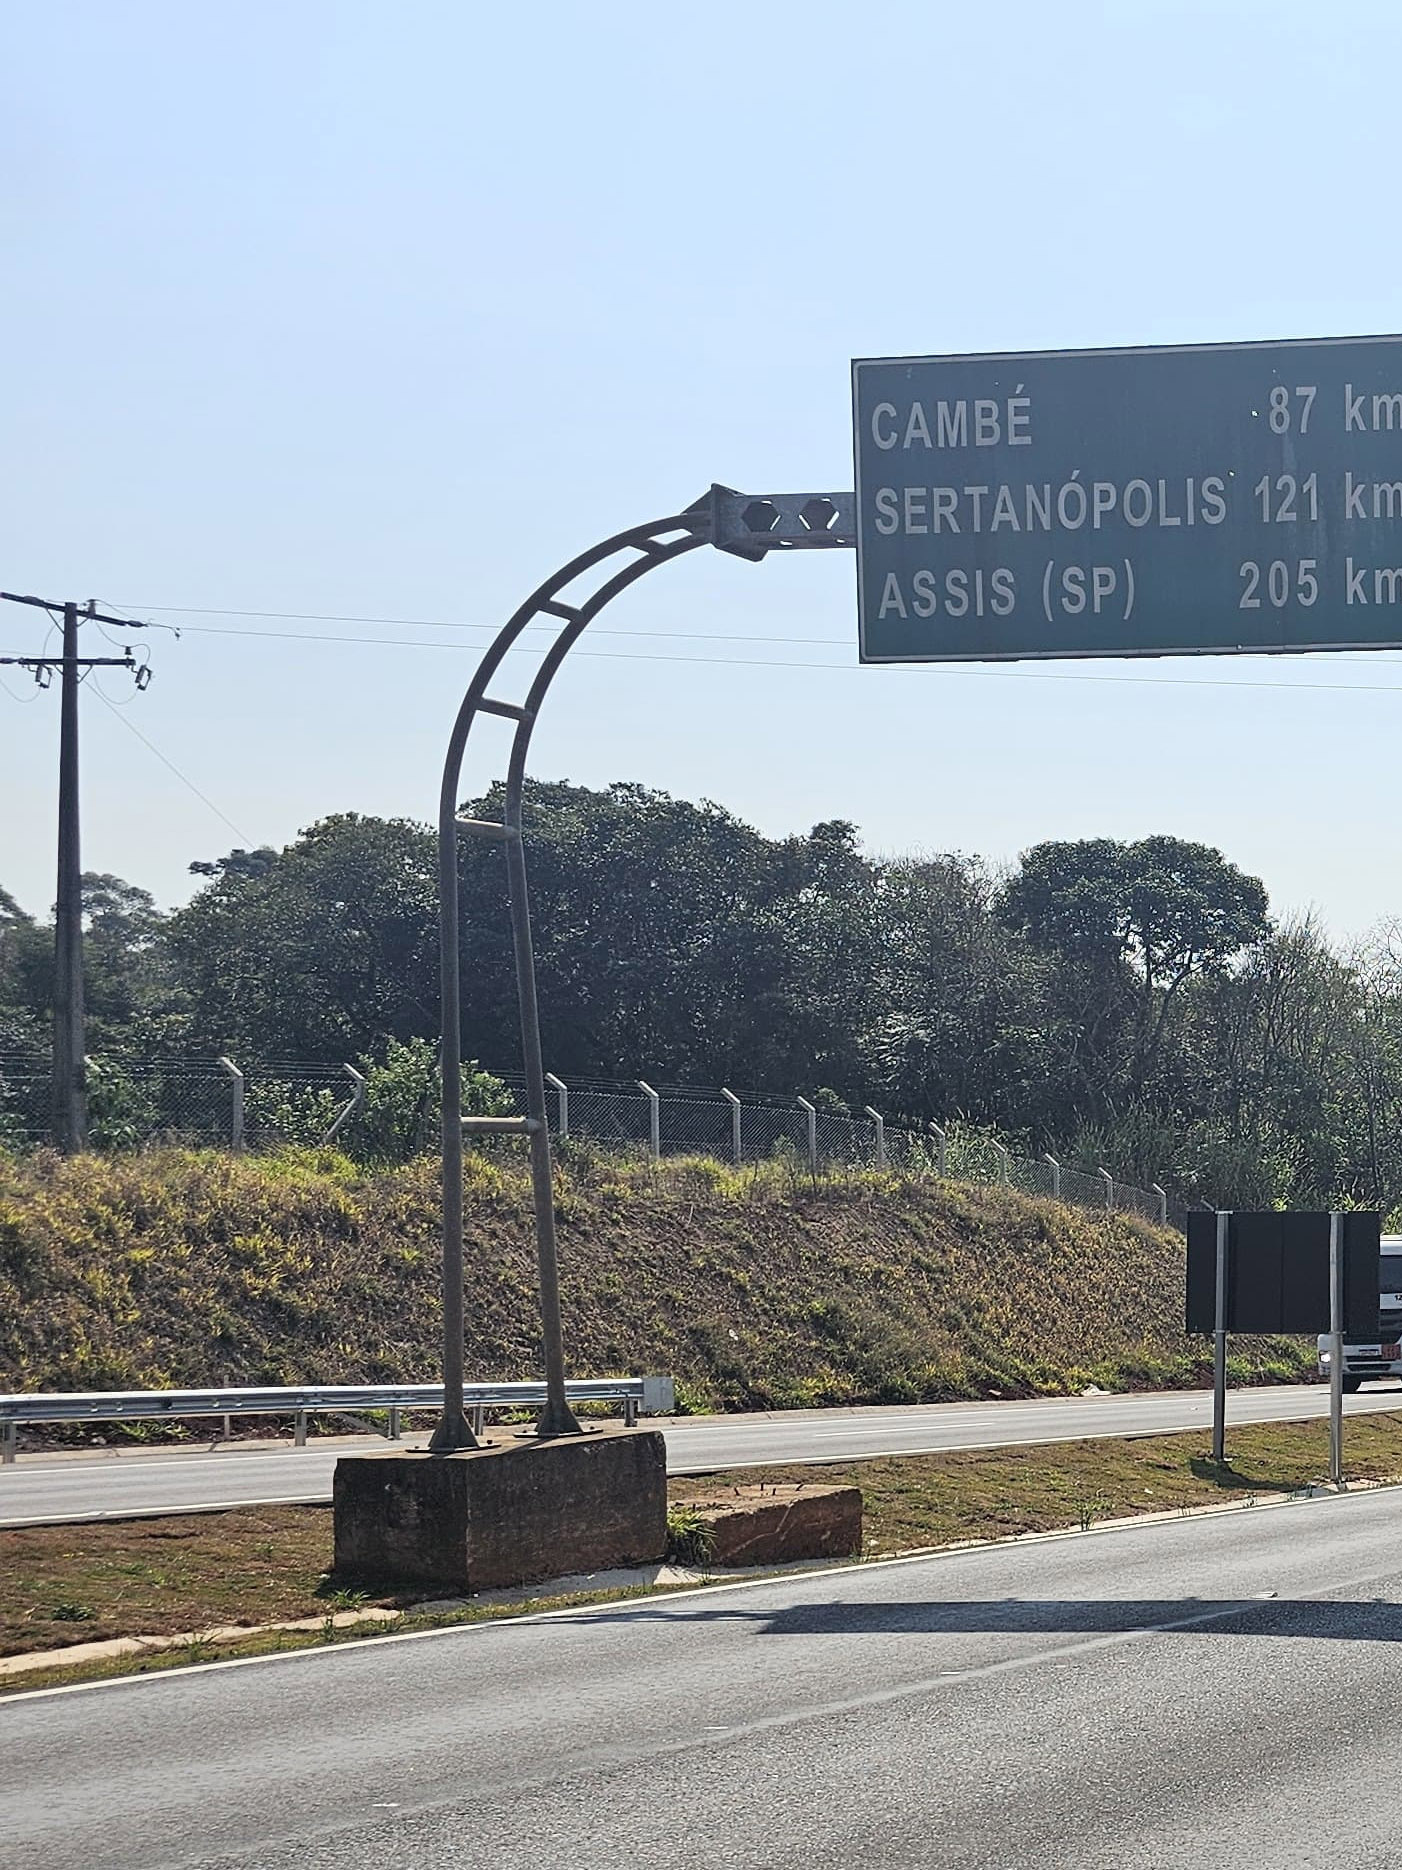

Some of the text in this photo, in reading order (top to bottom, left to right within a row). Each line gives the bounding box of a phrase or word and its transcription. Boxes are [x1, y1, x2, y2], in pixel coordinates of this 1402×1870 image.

[870, 383, 1033, 451] CAMBÉ
[1268, 385, 1318, 435] 87
[874, 469, 1228, 536] SERTANÓPOLIS
[1254, 471, 1319, 524] 121
[877, 566, 1017, 620] ASSIS
[1041, 557, 1136, 622] (SP)
[1238, 558, 1319, 610] 205
